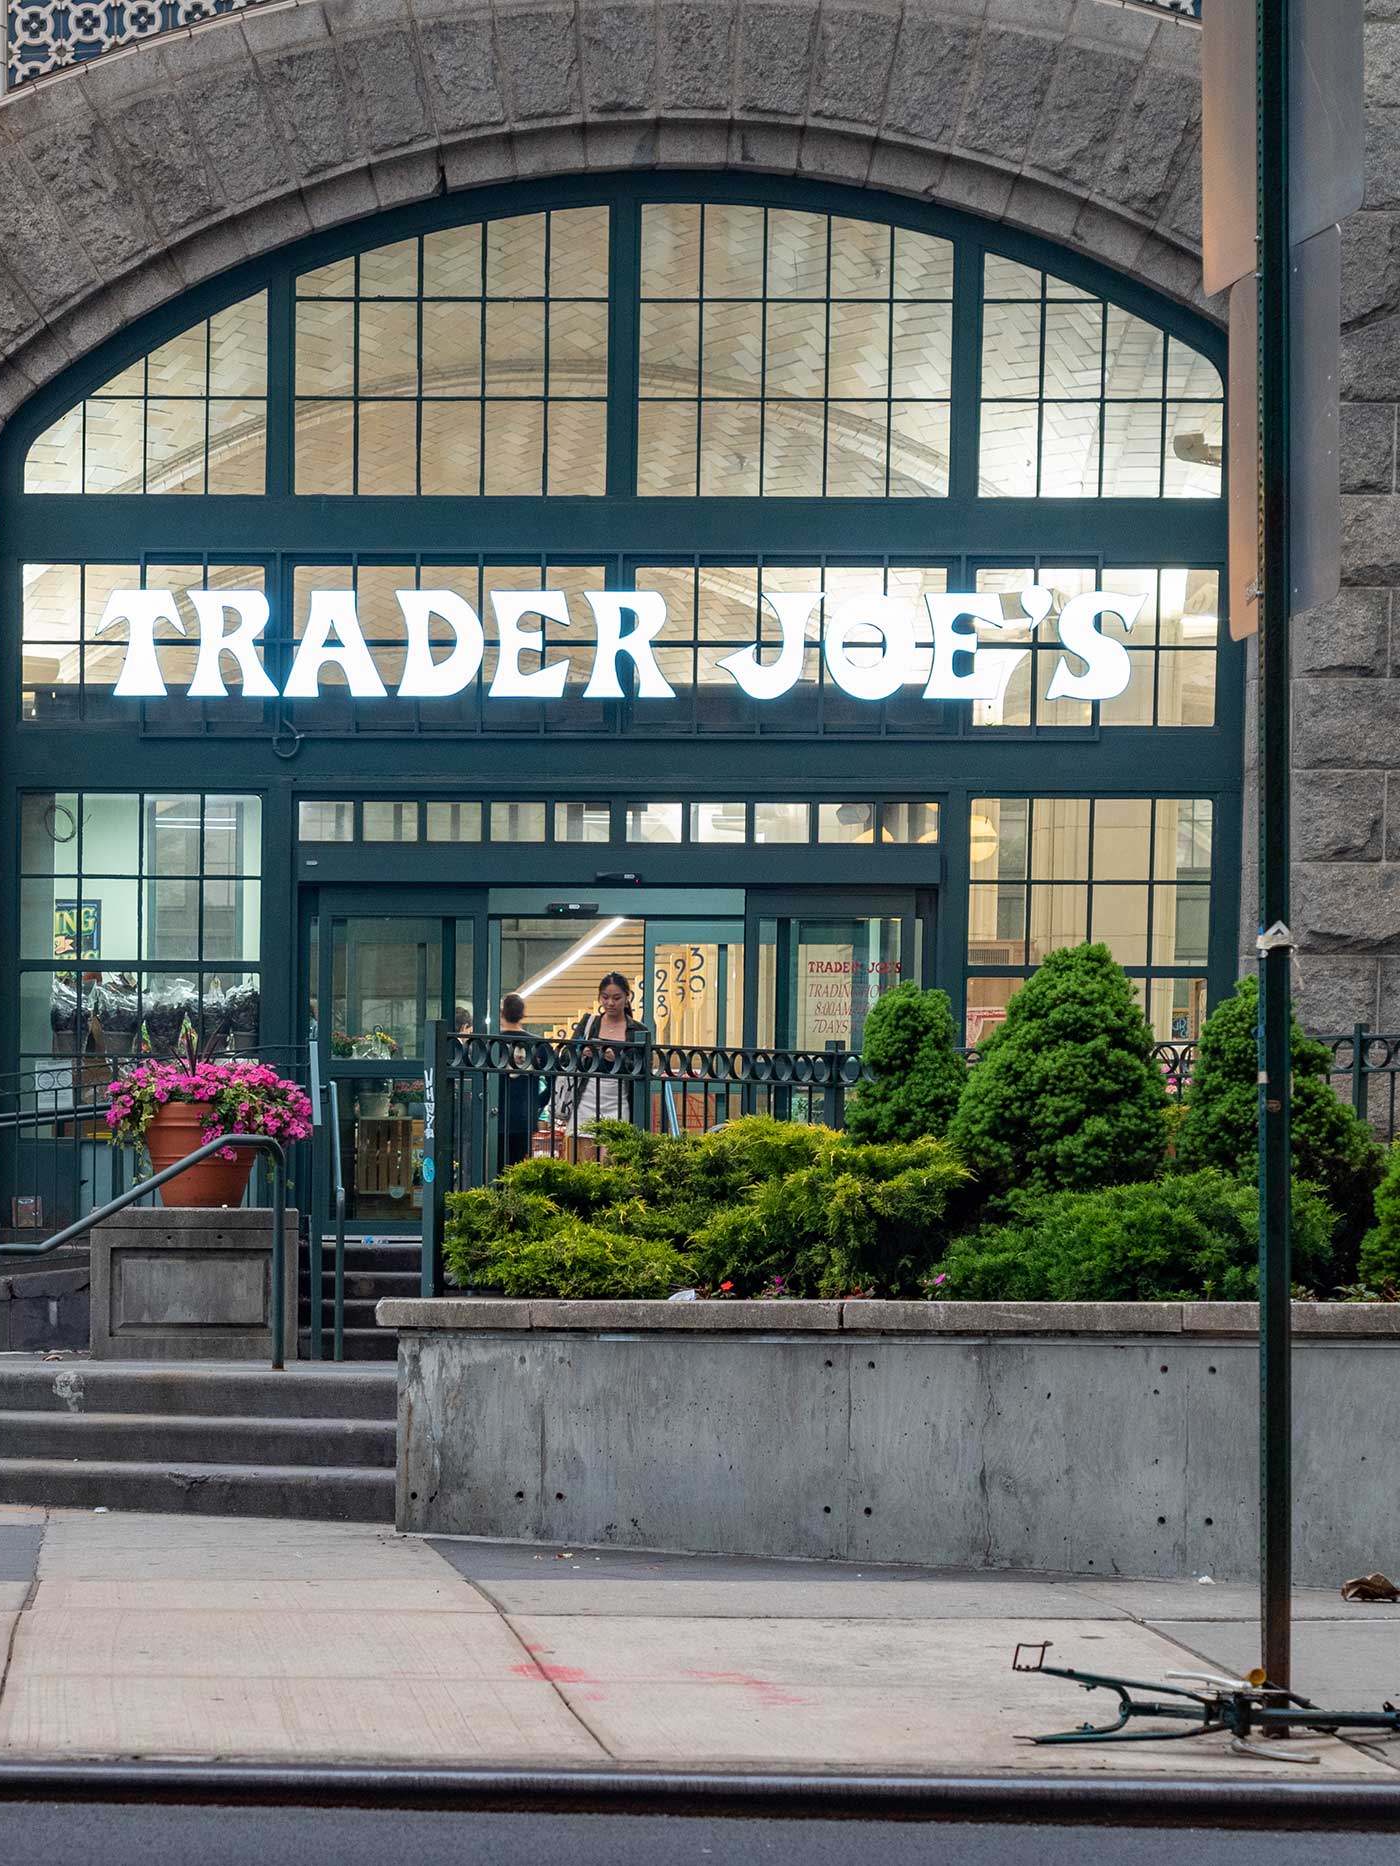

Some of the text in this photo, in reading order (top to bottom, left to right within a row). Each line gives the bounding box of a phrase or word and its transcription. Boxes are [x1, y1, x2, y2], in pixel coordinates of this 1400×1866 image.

[94, 584, 1149, 700] TRADER JOE'S
[808, 961, 902, 974] TRADER JOE'S
